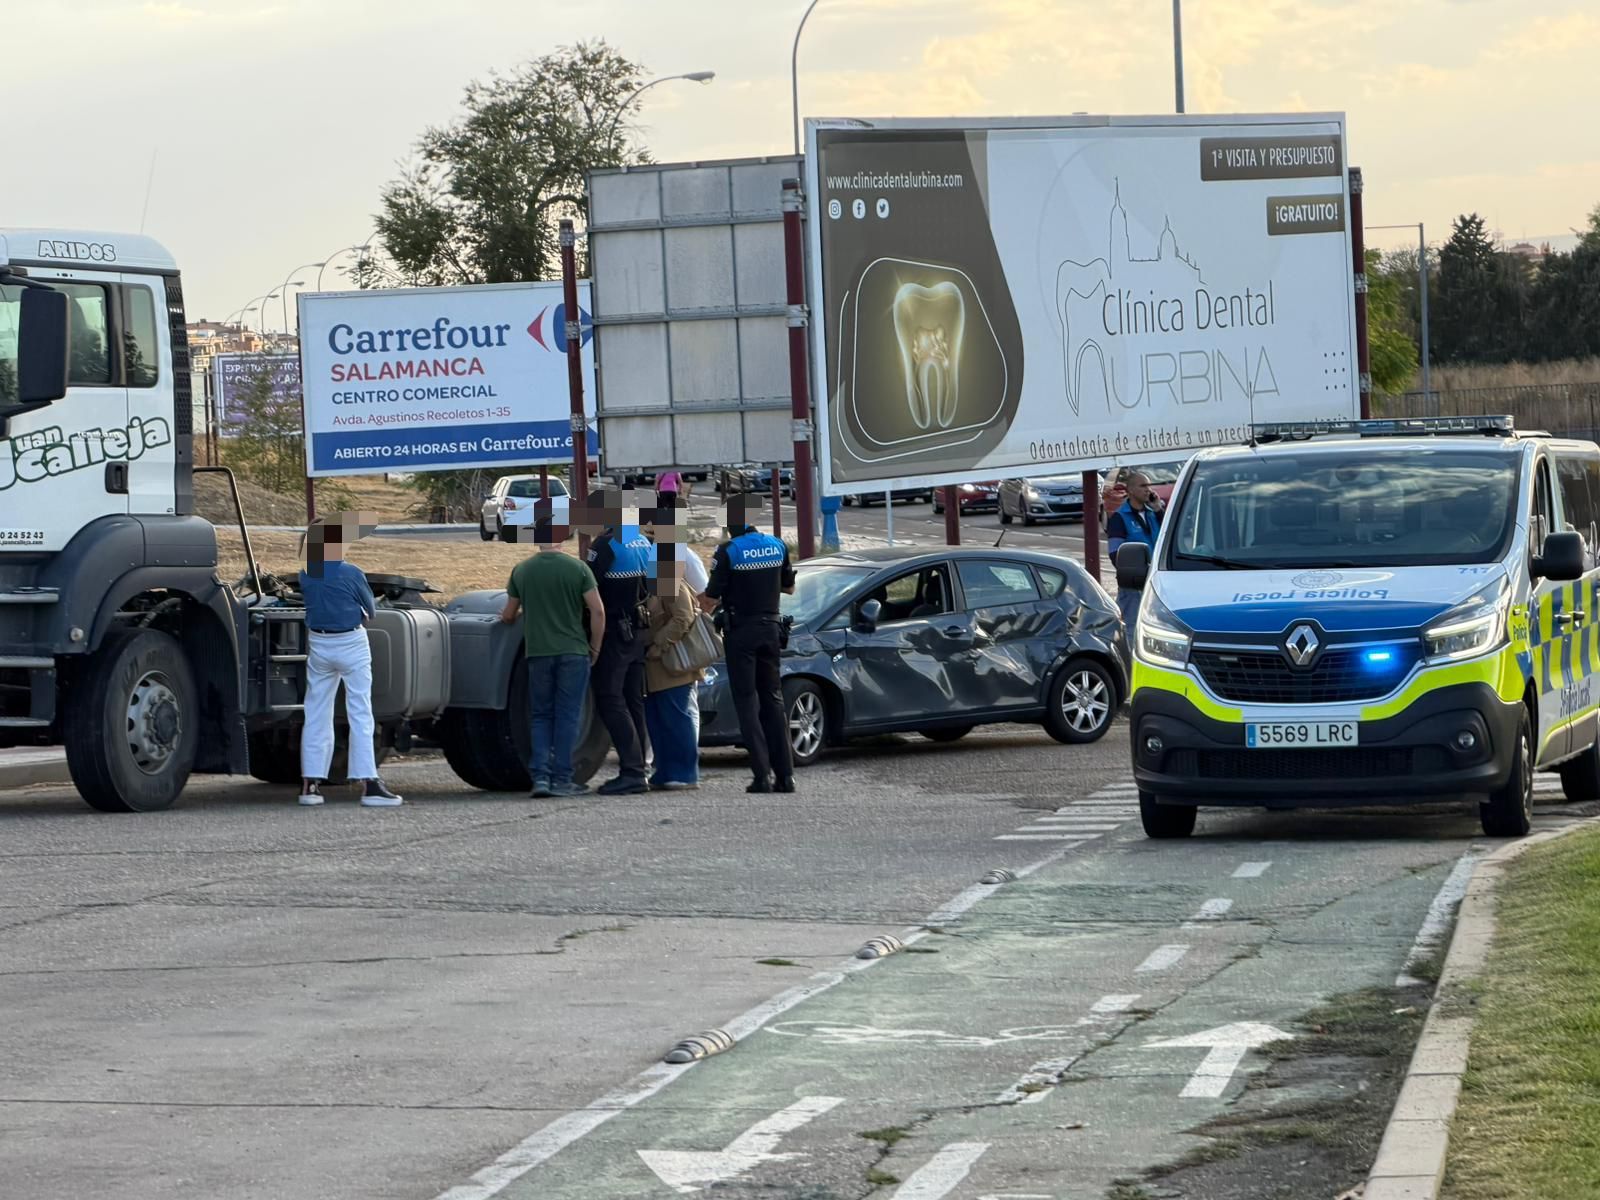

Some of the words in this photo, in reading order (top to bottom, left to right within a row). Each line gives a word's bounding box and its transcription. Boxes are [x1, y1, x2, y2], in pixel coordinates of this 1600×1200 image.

[1226, 148, 1257, 167] VISITA
[1260, 149, 1267, 166] Y
[1269, 146, 1335, 165] PRESUPUESTO
[827, 171, 963, 189] www.clinicadentalurbina.com
[1275, 203, 1338, 223] ¡GRATUITO!
[38, 240, 116, 262] ARIDOS
[1103, 287, 1184, 335] Clínica
[1195, 280, 1274, 330] Dental
[328, 317, 511, 355] Carrefour
[330, 357, 485, 382] SALAMANCA
[1111, 346, 1280, 409] URBINA
[332, 389, 399, 405] CENTRO
[403, 385, 498, 401] COMERCIAL
[333, 415, 365, 425] Avda.
[368, 411, 425, 425] Agustinos
[427, 408, 484, 420] Recoletos
[486, 406, 511, 417] 1-35
[334, 446, 392, 459] ABIERTO
[394, 445, 410, 456] 24
[412, 442, 457, 455] HORAS
[460, 442, 477, 452] EN
[481, 434, 574, 452] Carrefour.e
[1030, 434, 1109, 460] Odontología
[1116, 432, 1129, 451] de
[1135, 426, 1180, 450] calidad
[1186, 431, 1192, 445] a
[1198, 429, 1212, 443] un
[7, 531, 18, 539] 24
[20, 531, 31, 539] 52
[33, 531, 44, 539] 43
[1259, 724, 1308, 743] 5569
[1316, 724, 1353, 742] LRC
